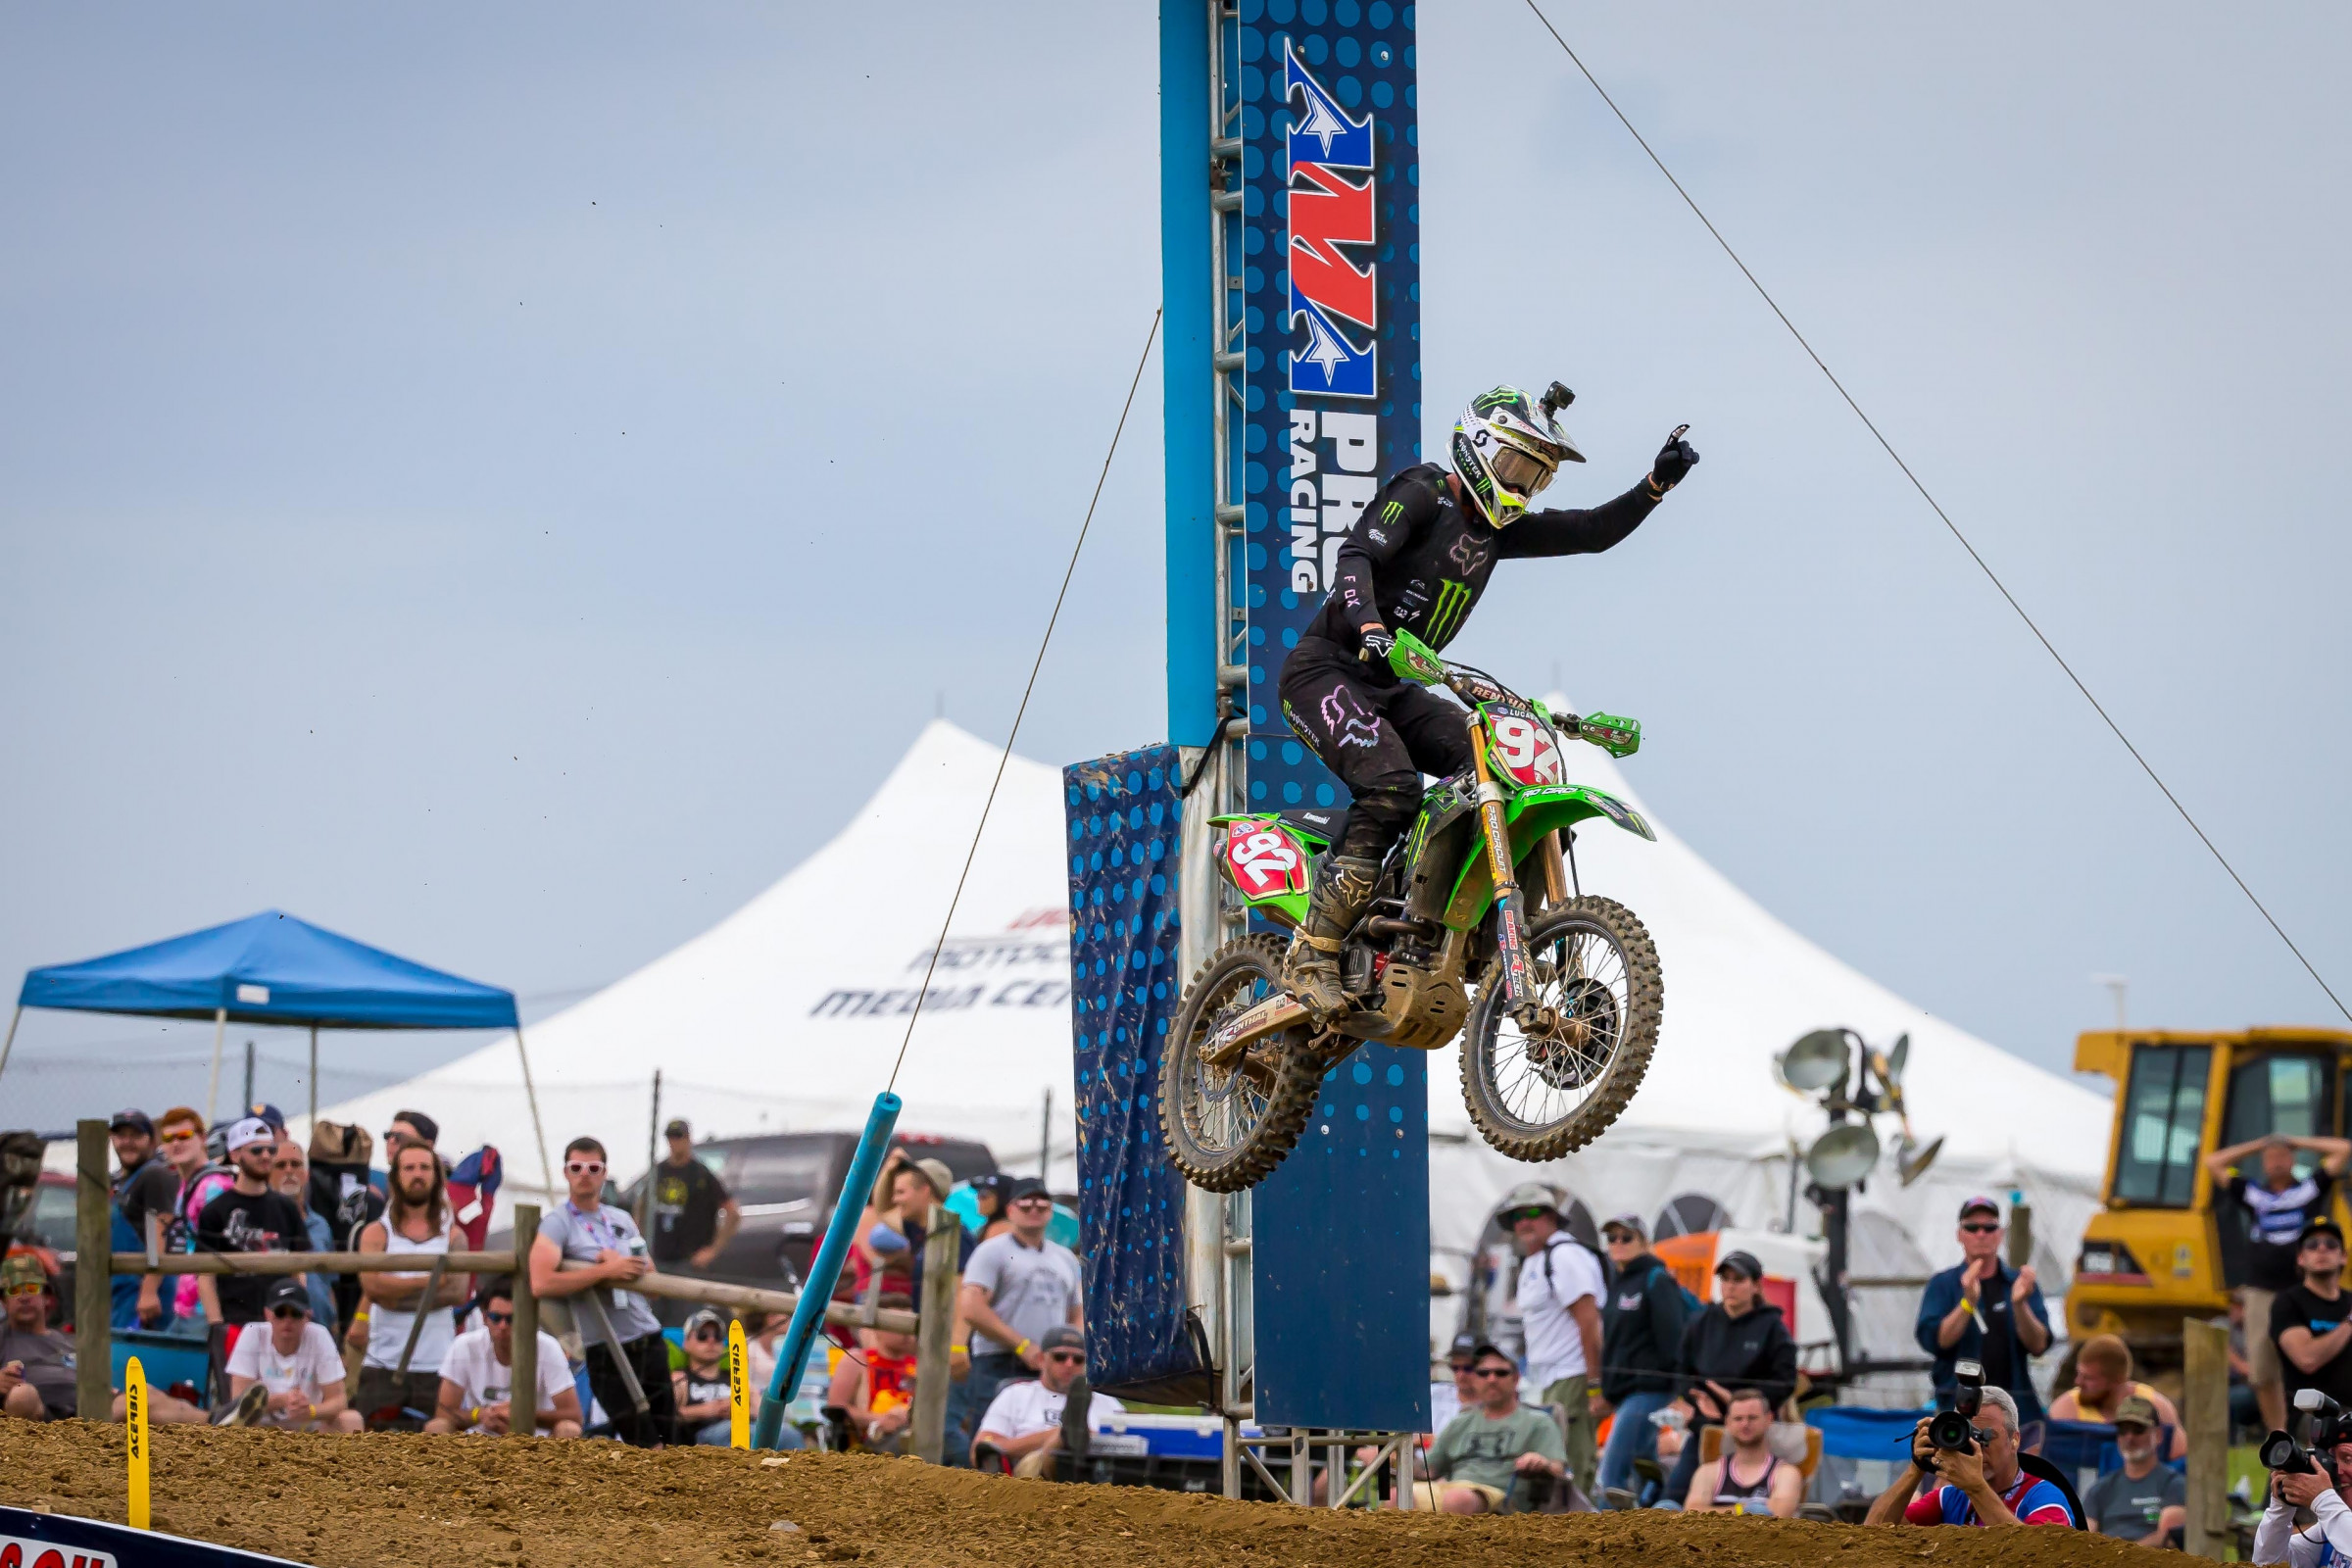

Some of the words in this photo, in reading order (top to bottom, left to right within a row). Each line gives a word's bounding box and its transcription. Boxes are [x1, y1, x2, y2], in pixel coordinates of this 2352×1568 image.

[1284, 35, 1377, 400] AMA
[1457, 437, 1482, 478] MONSTER
[1290, 409, 1318, 594] RACING
[1344, 574, 1360, 608] FOX
[1405, 589, 1429, 601] DUNLOP
[1494, 716, 1558, 783] 92
[1302, 812, 1331, 825] Kawasaki
[1487, 805, 1498, 830] PRO
[1231, 832, 1298, 888] 92
[1492, 829, 1507, 874] CIRCUIT
[1505, 910, 1517, 950] BRAKING
[808, 986, 986, 1018] MEDIA
[1218, 1010, 1268, 1049] RENTHAL
[732, 1343, 742, 1406] ACERBIS
[129, 1384, 139, 1459] ACERBIS
